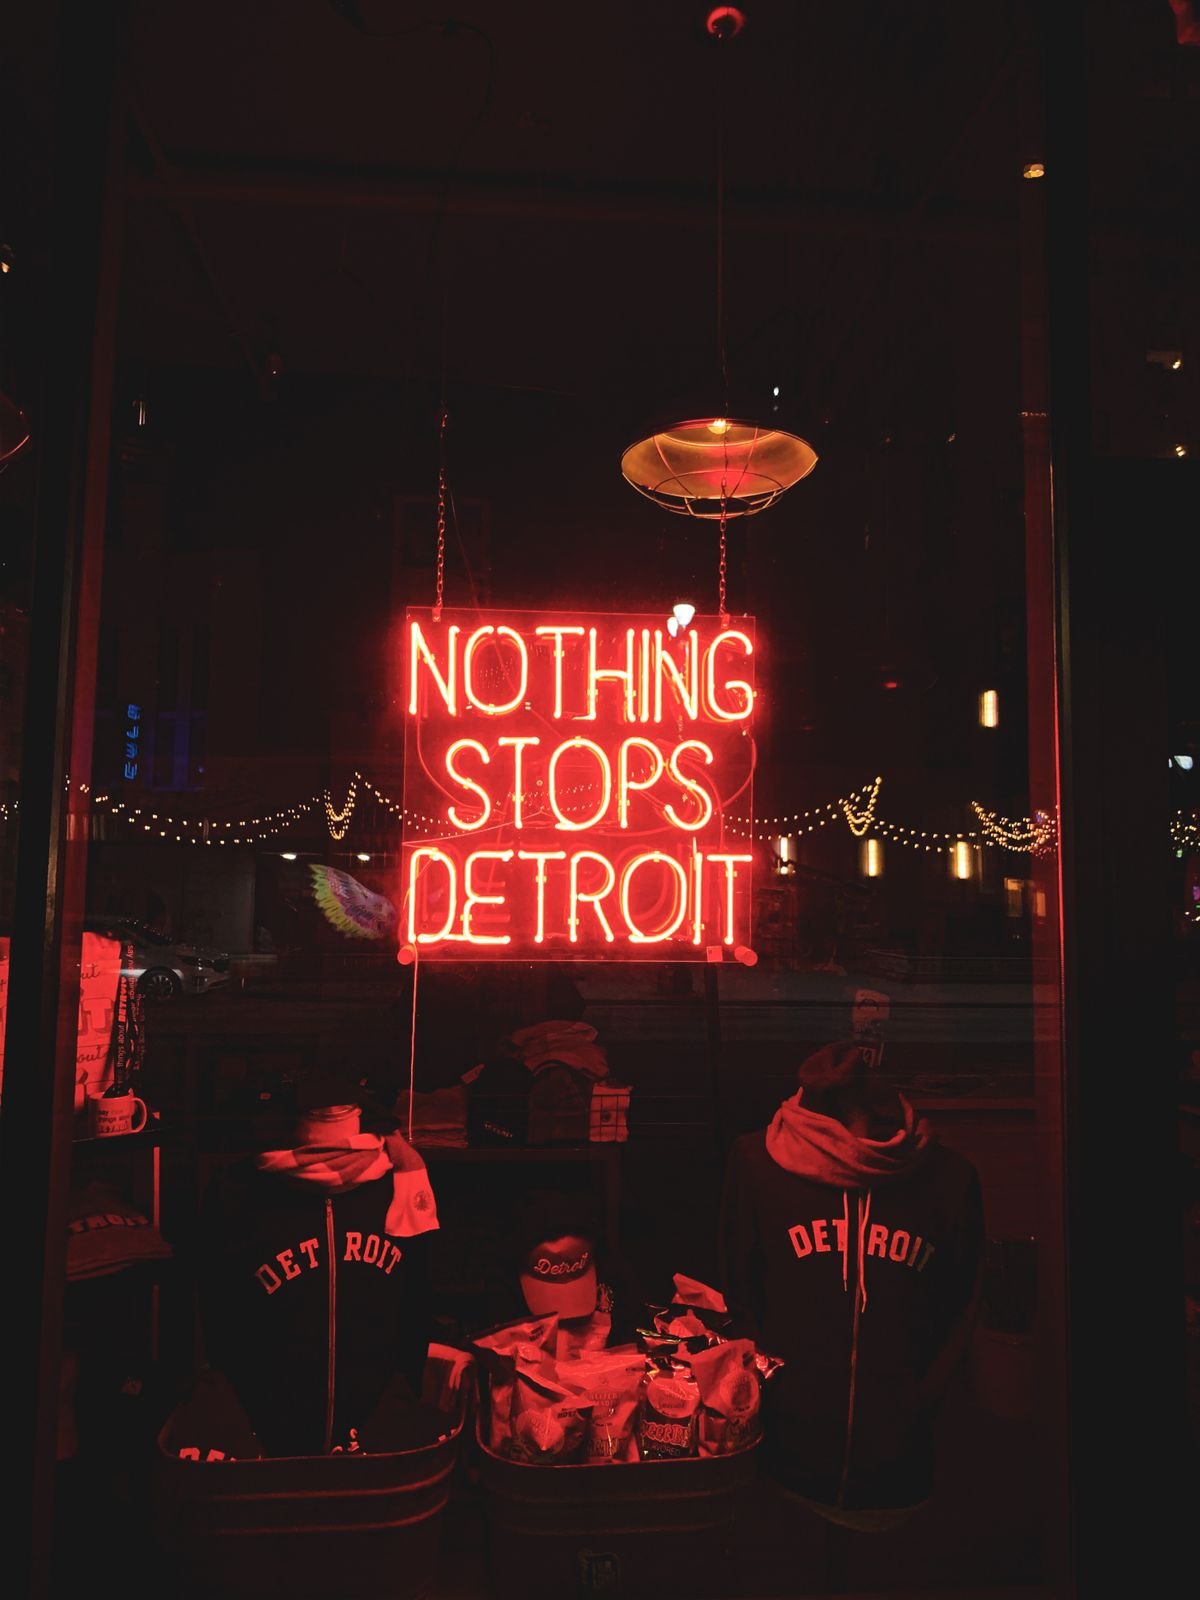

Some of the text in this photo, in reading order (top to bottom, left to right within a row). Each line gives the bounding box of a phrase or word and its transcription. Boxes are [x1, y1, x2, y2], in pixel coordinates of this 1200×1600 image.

[408, 621, 755, 723] NOTHING
[445, 735, 713, 832] STOPS
[407, 846, 754, 946] DETROIT
